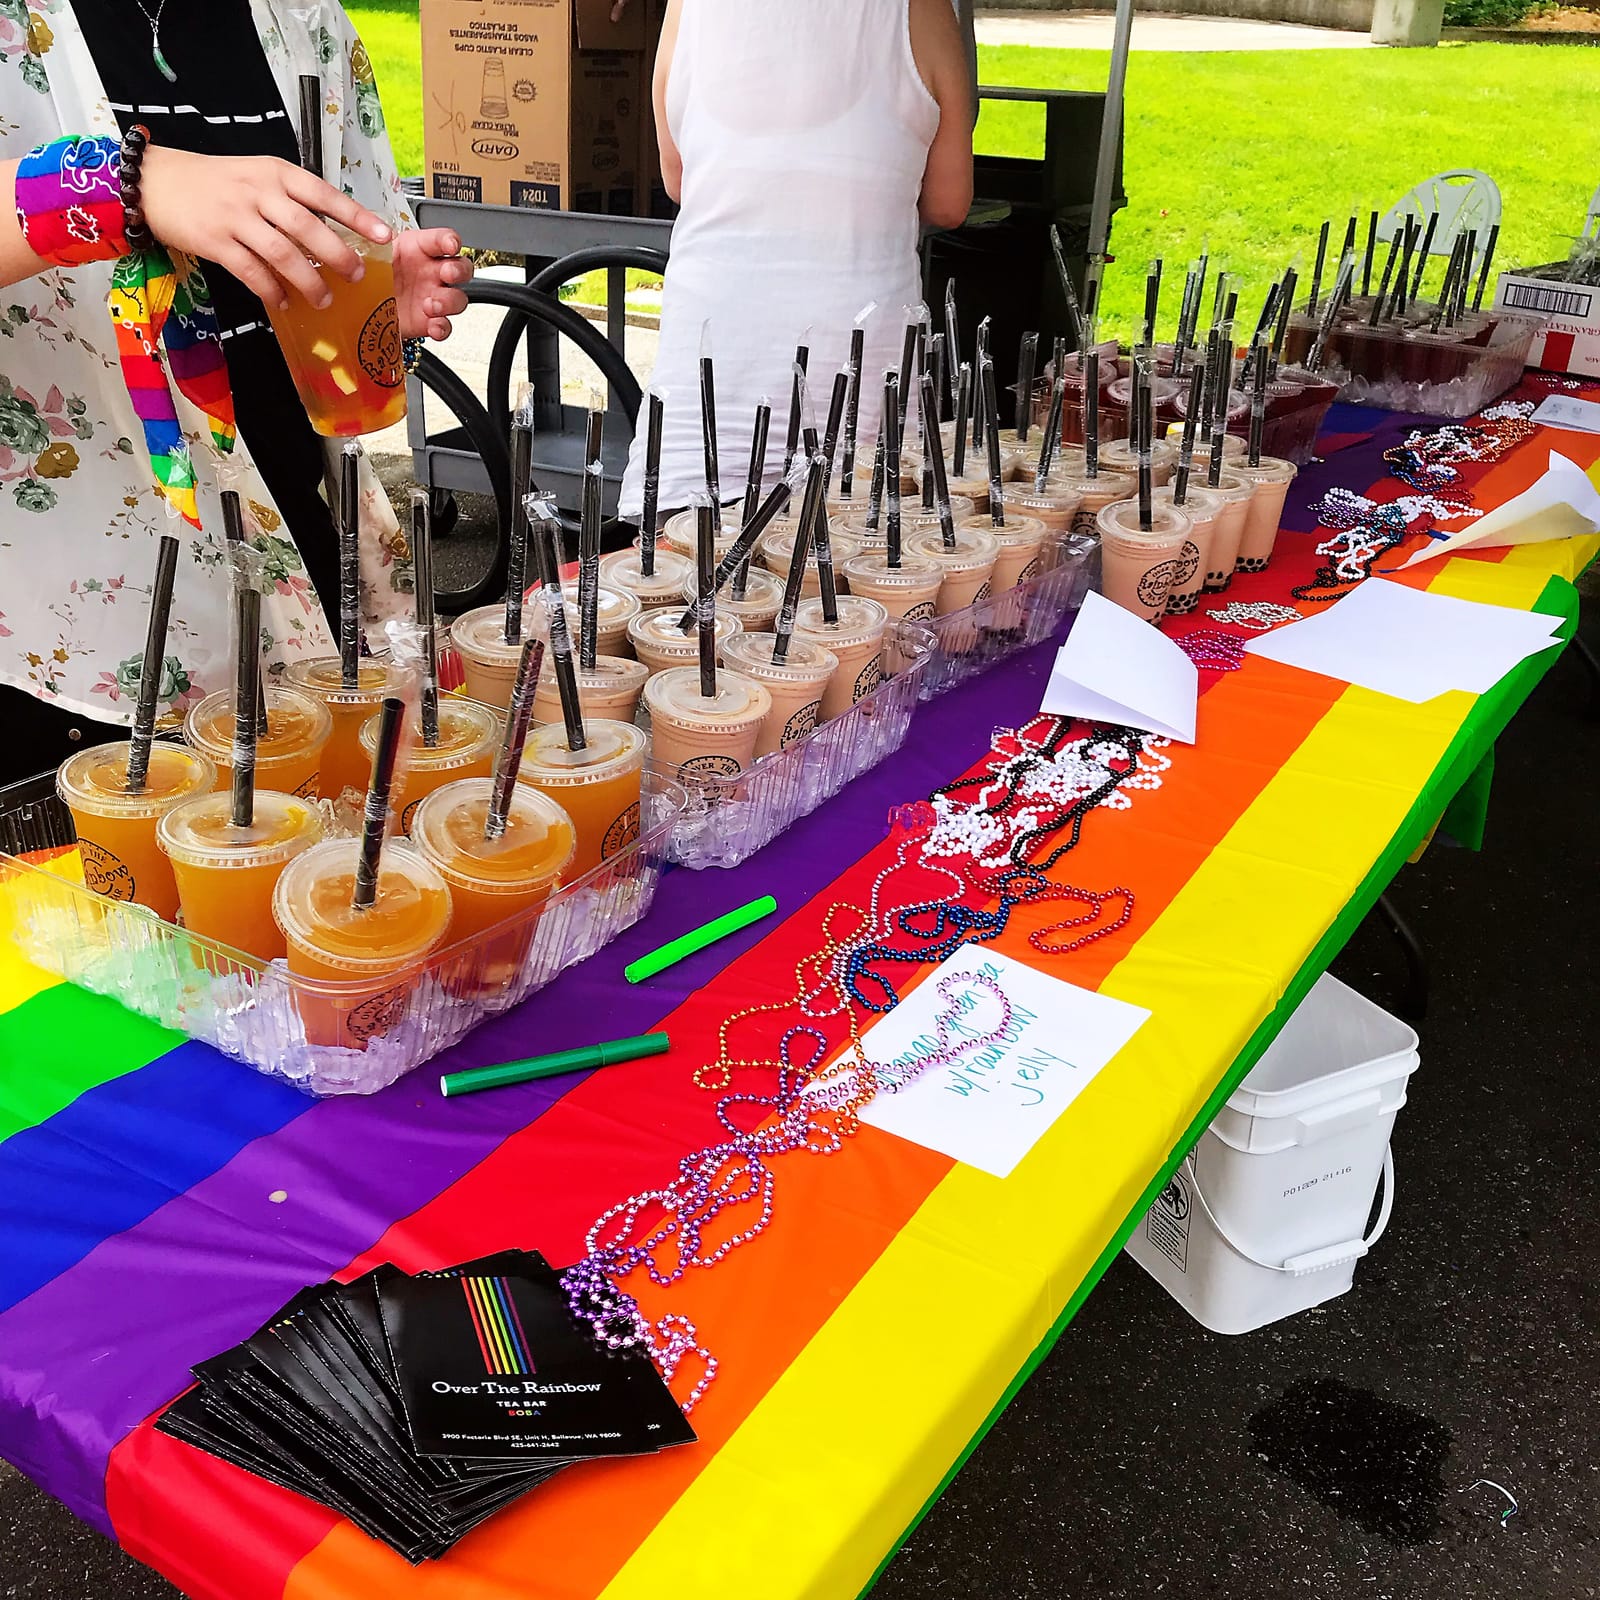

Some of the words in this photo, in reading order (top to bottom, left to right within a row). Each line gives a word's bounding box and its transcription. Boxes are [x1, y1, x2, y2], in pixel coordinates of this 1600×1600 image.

[507, 23, 518, 32] DE
[449, 29, 513, 41] TRANSPARENTES
[513, 33, 539, 43] VASOS
[454, 43, 475, 52] CUPS
[476, 45, 507, 55] PLASTIC
[508, 47, 534, 56] CLEAR
[477, 143, 513, 156] DART
[521, 188, 549, 204] TD24
[367, 320, 383, 352] OVER
[431, 1381, 479, 1395] Over
[480, 1381, 521, 1395] The
[521, 1381, 602, 1395] Rainbow
[495, 1400, 520, 1408] TEA
[523, 1400, 547, 1408] BAR
[508, 1409, 541, 1417] BOBA
[585, 1432, 599, 1440] WA
